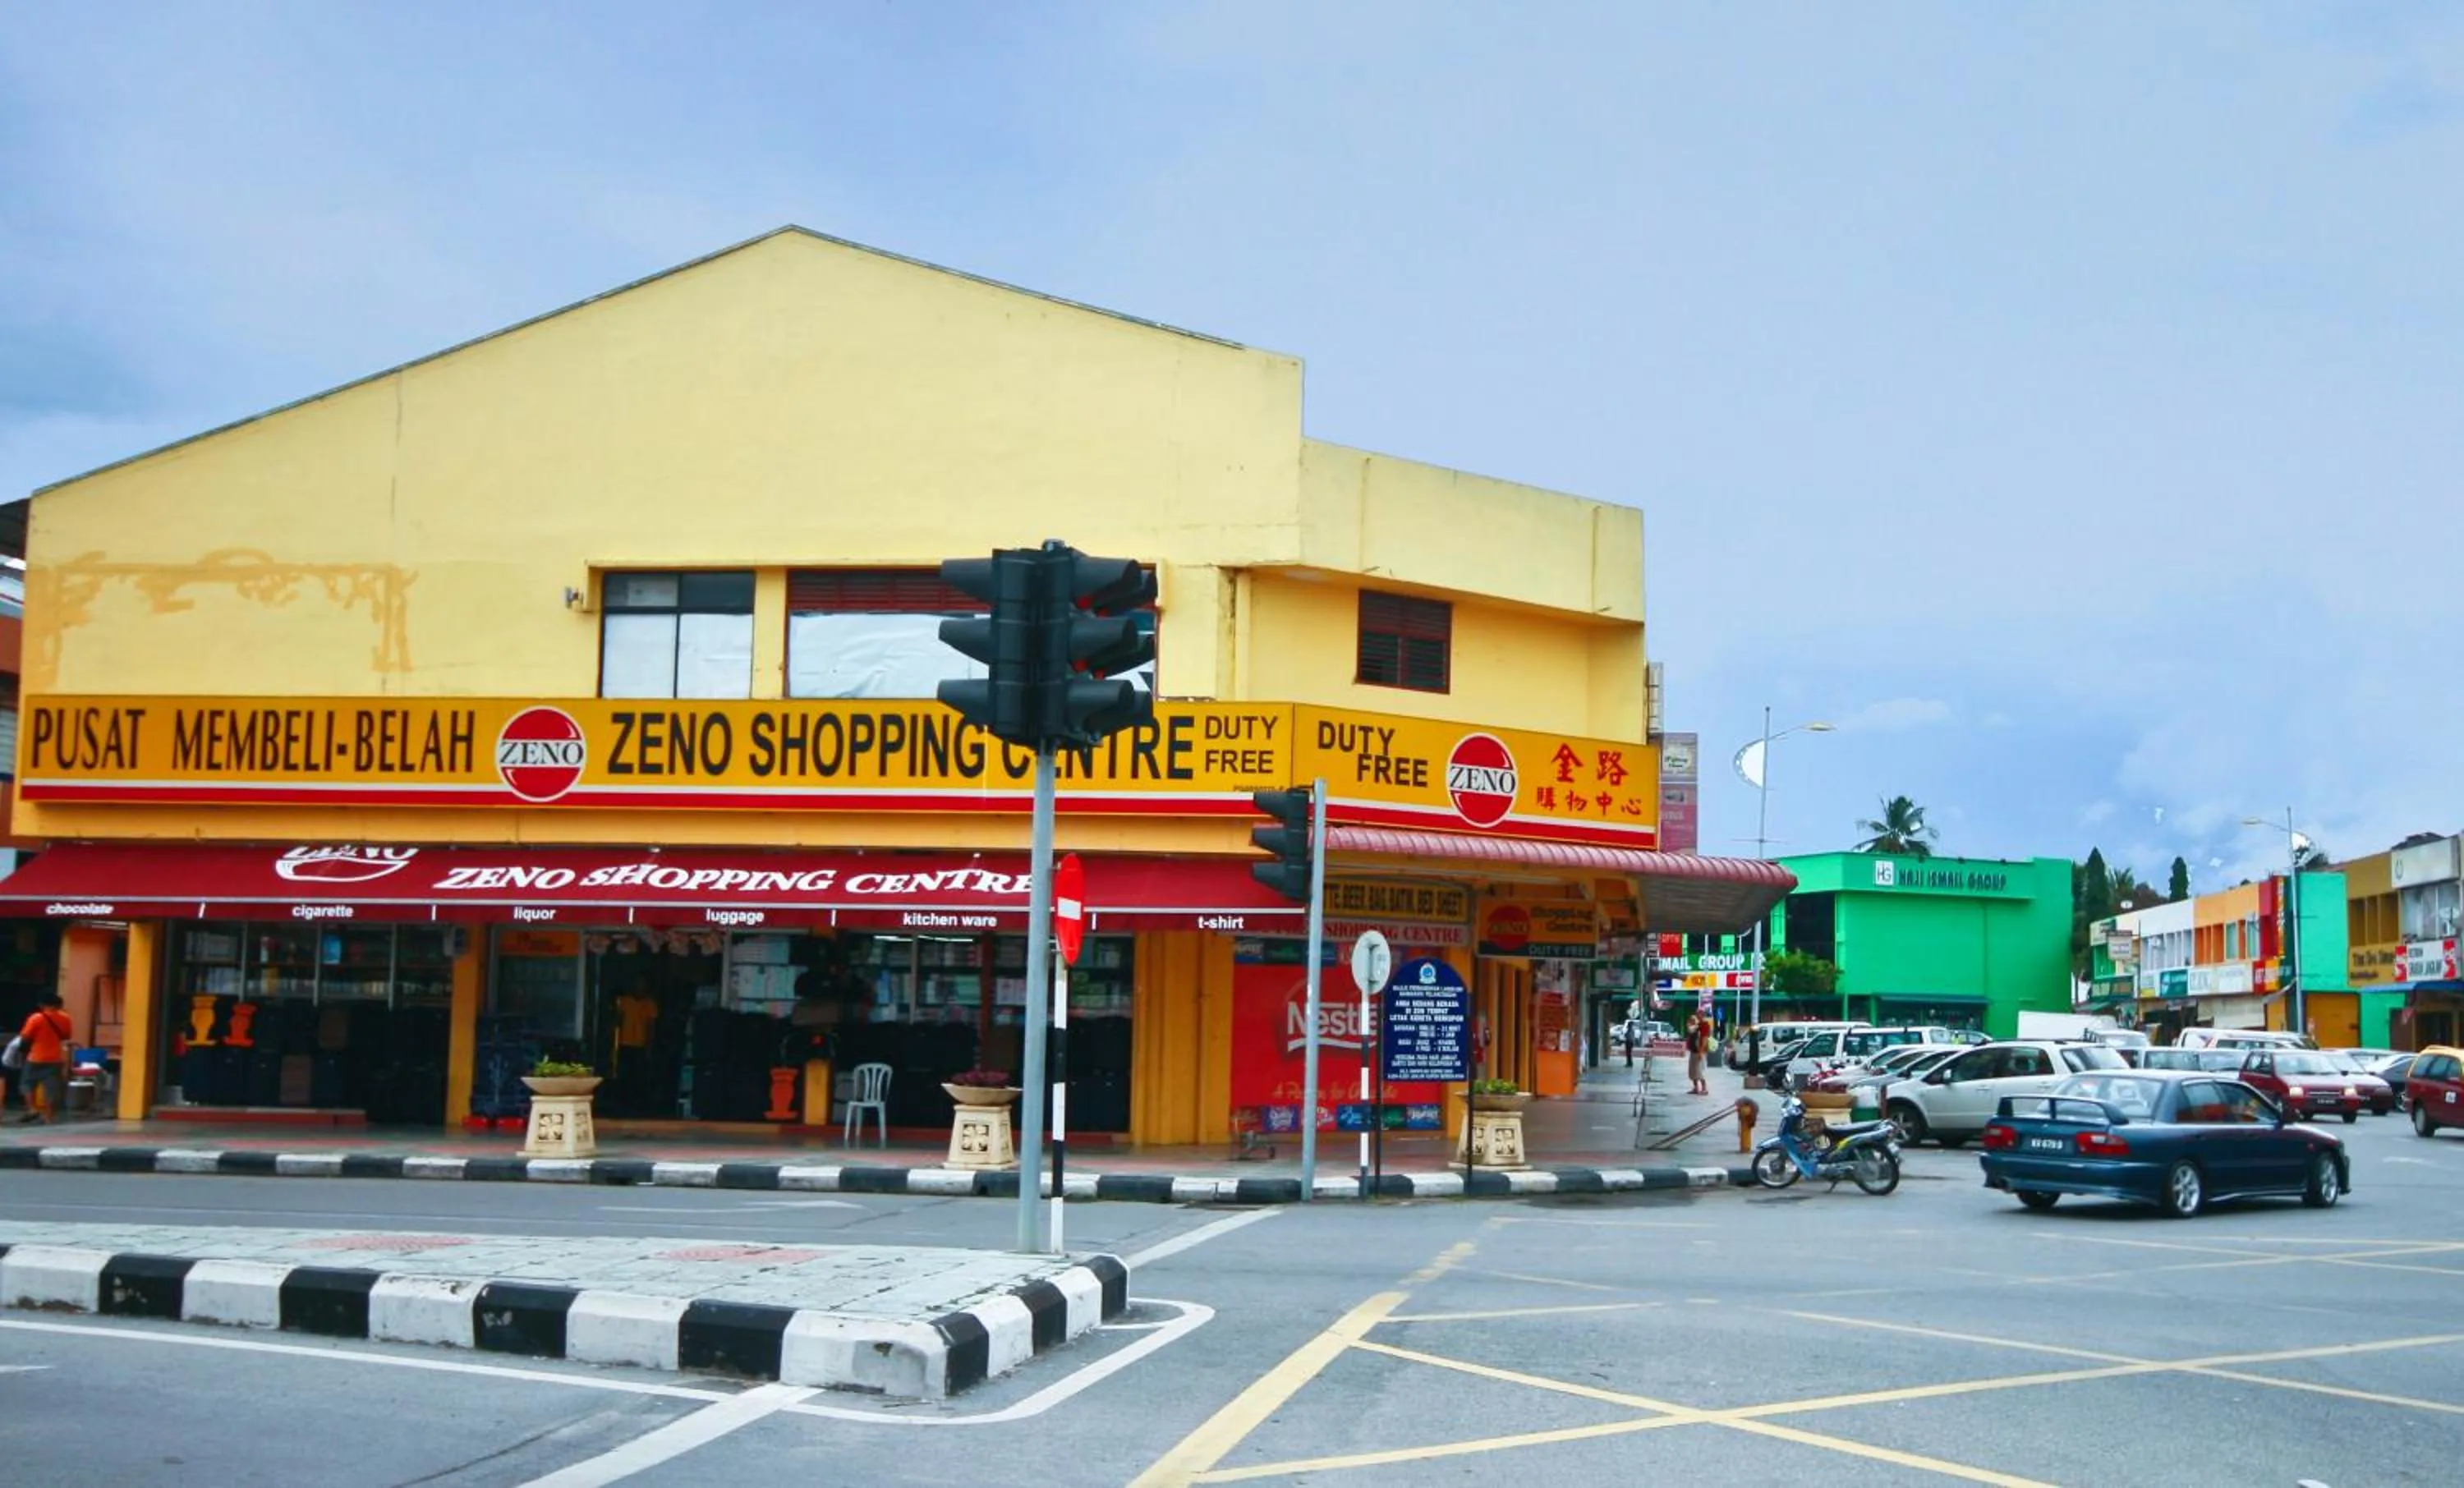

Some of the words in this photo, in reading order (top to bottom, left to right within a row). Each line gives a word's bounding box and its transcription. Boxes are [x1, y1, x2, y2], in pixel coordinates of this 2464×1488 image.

[1204, 715, 1278, 742] DUTY
[1317, 719, 1395, 755] DUTY
[32, 706, 147, 770] PUSAT
[171, 709, 476, 774] MEMBELI-BELAH
[608, 711, 732, 776] ZENO
[749, 712, 986, 779] SHOPPING
[1001, 714, 1195, 780] CNTRE
[499, 741, 585, 767] ZENO
[1204, 749, 1275, 774] FREE
[1357, 752, 1428, 788] FREE
[1449, 764, 1516, 796] ZENO
[433, 866, 576, 889] ZENO
[579, 863, 835, 891] SHOPPING
[1967, 872, 2007, 892] GROUP
[46, 903, 113, 915] chocolate
[292, 904, 353, 921] cigarette
[513, 906, 556, 921] liquor
[706, 908, 765, 925] luggage
[903, 912, 958, 926] kitchen
[962, 916, 998, 927] ware
[1198, 915, 1244, 930] t-shirt
[1403, 925, 1463, 943] CENTRE
[1528, 944, 1561, 957] DUTY
[1658, 957, 1692, 971] MAIL
[1698, 954, 1745, 970] GROUP
